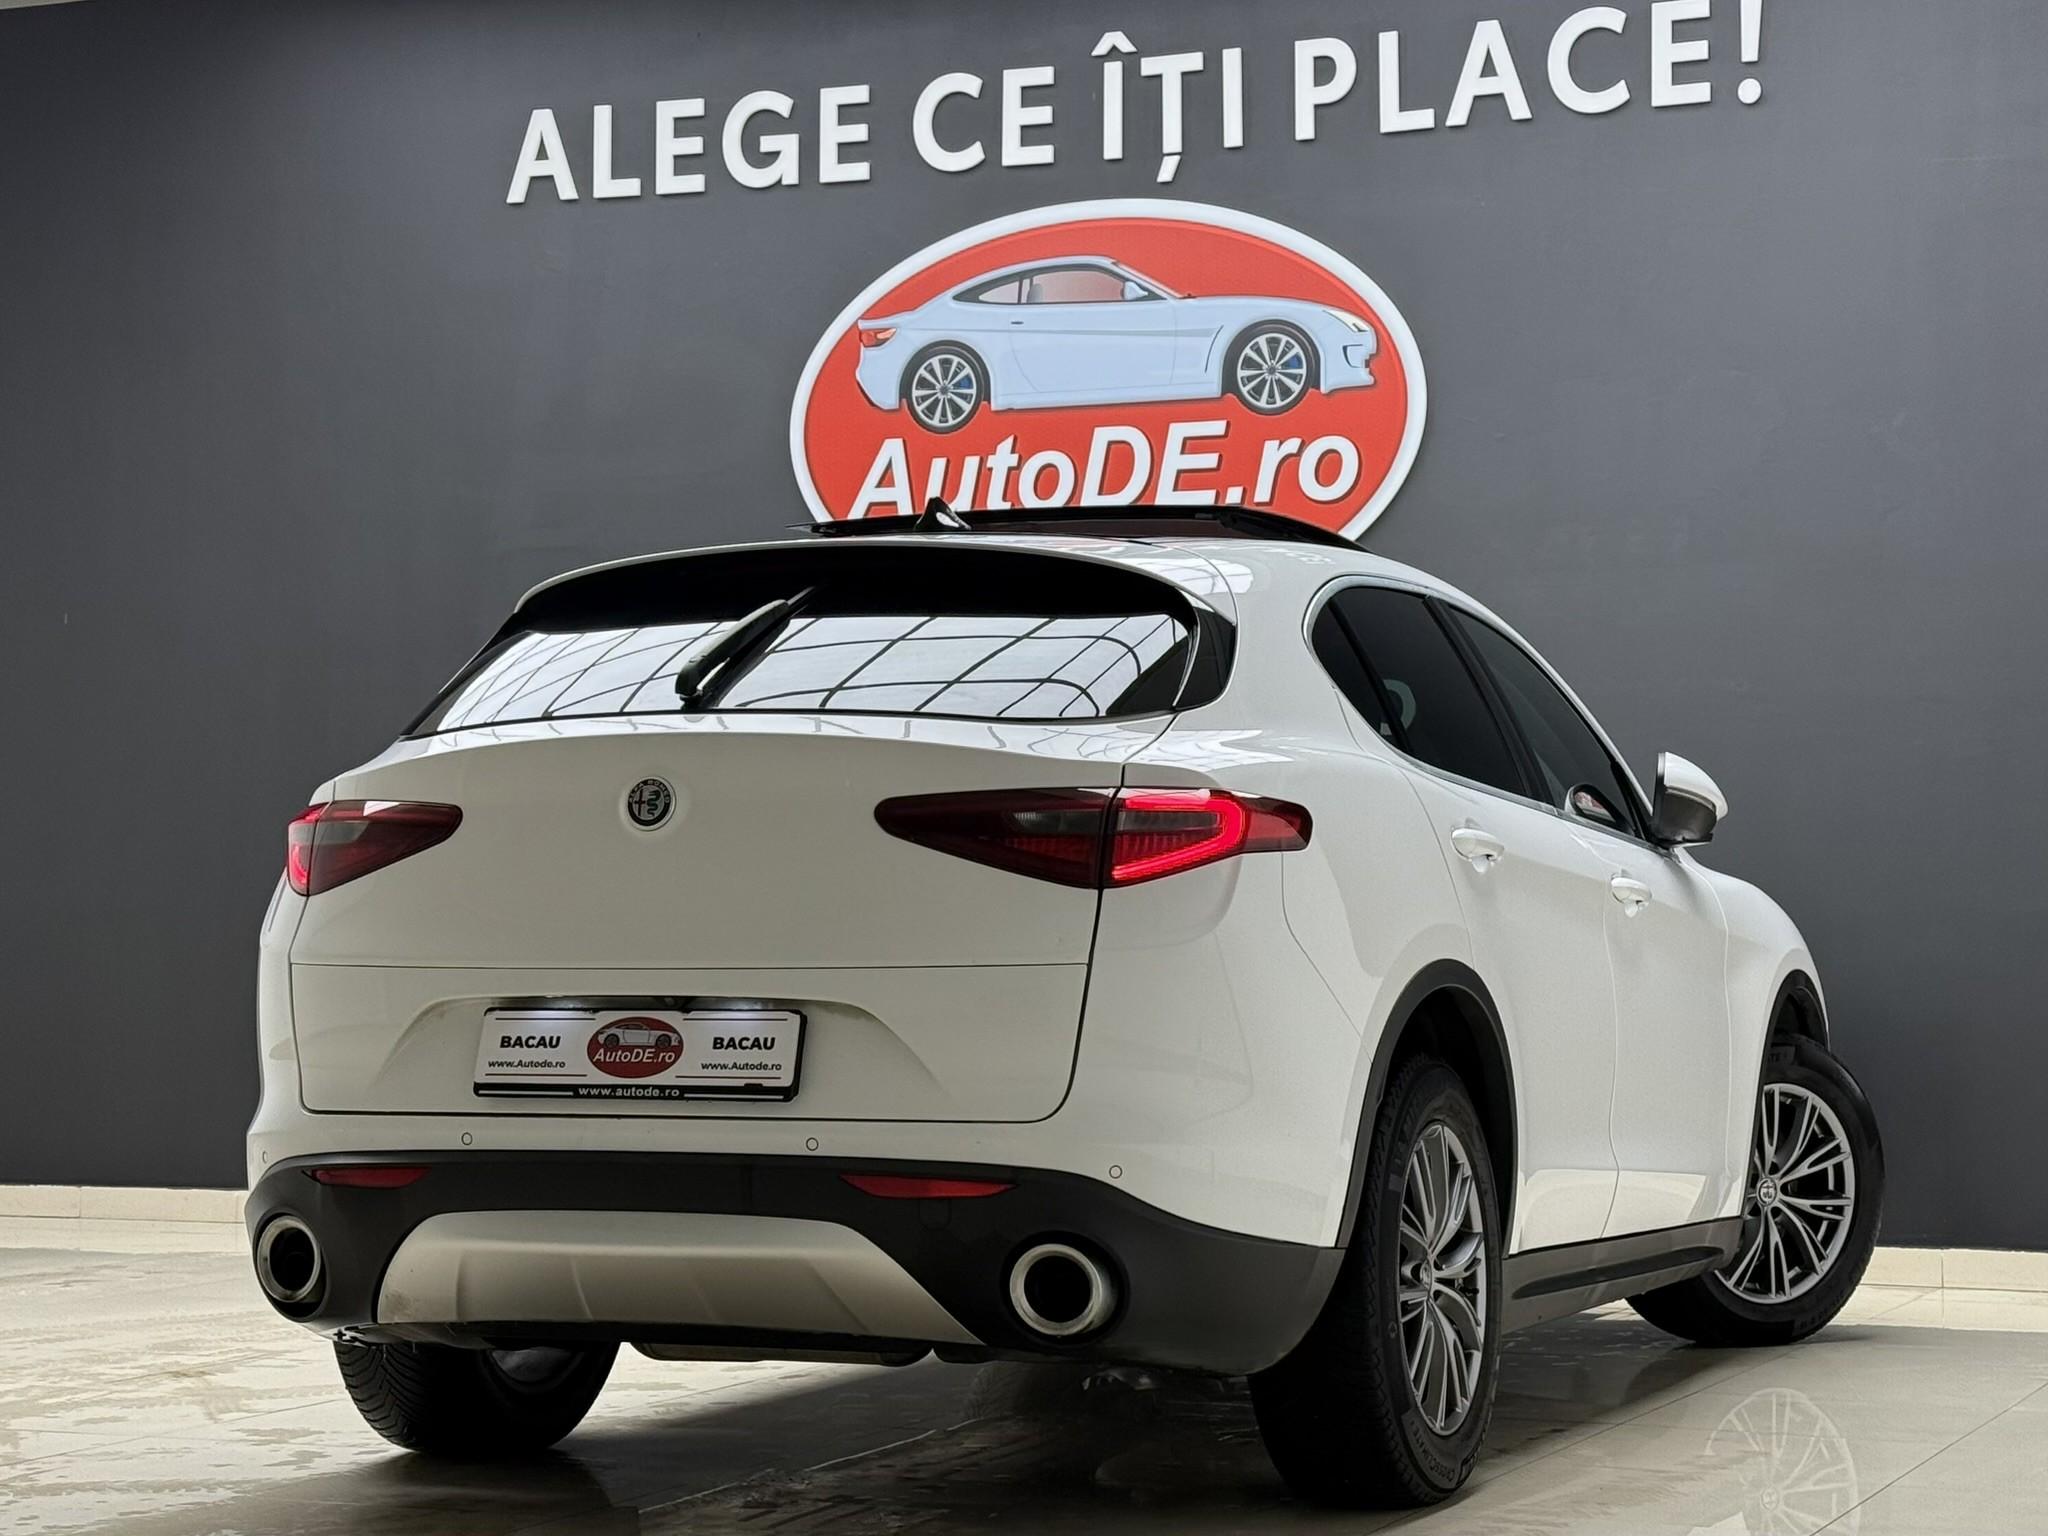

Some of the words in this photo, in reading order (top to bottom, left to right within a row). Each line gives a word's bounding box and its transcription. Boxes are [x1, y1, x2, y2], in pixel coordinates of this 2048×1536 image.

[506, 84, 870, 204] ALEGE
[912, 65, 1055, 173] CE
[1294, 0, 1763, 141] PLACE!
[847, 419, 1361, 519] AutoDE.ro
[500, 1035, 561, 1049] BACAU
[712, 1036, 776, 1050] BACAU
[593, 1048, 676, 1063] AutoDE.ro
[488, 1059, 566, 1069] www.Autode.ro
[701, 1061, 782, 1071] www.Autode.ro
[578, 1086, 680, 1097] www.autode.ro
